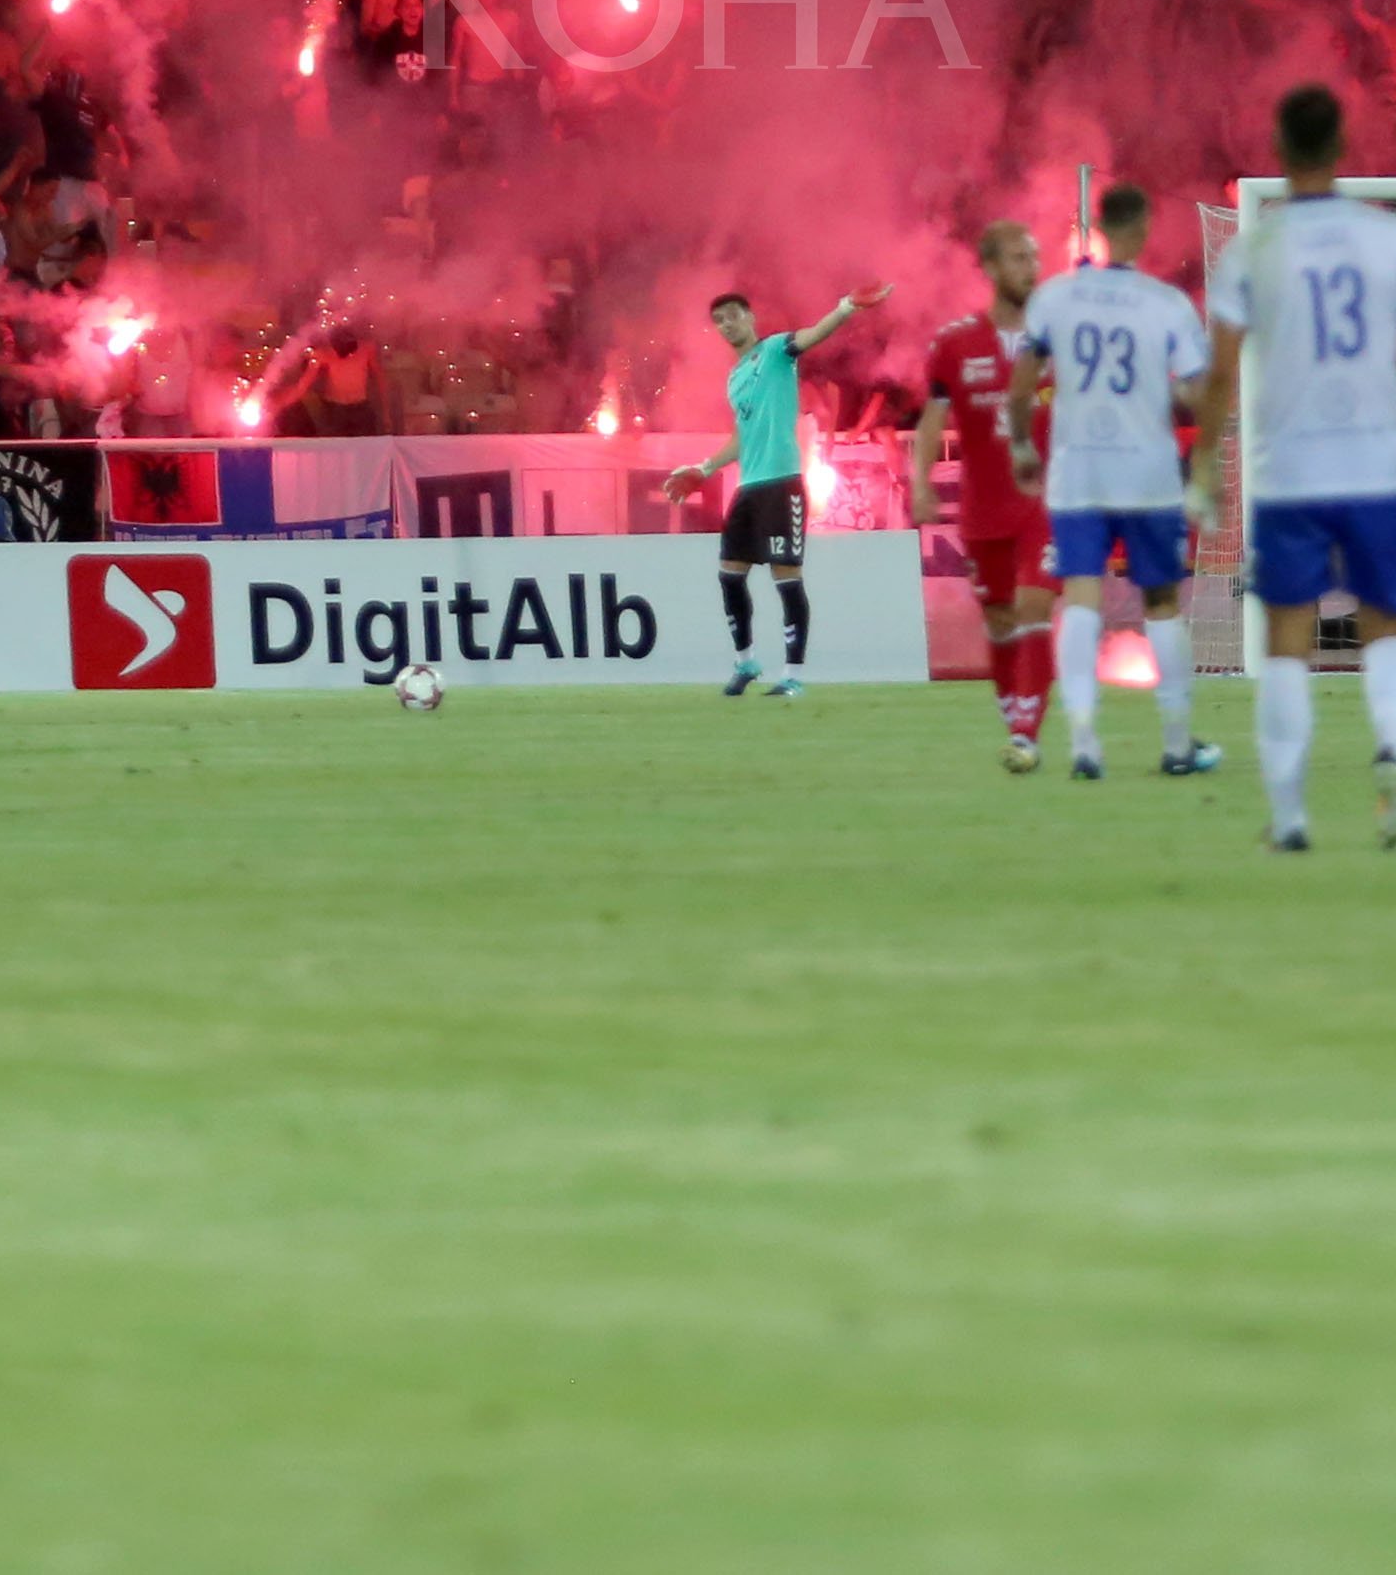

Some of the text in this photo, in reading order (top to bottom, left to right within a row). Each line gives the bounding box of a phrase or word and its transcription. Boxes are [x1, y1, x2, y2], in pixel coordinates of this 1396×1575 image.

[1302, 263, 1367, 362] 13
[1073, 321, 1137, 395] 93
[769, 535, 785, 555] 12
[248, 572, 658, 685] DigitAlb
